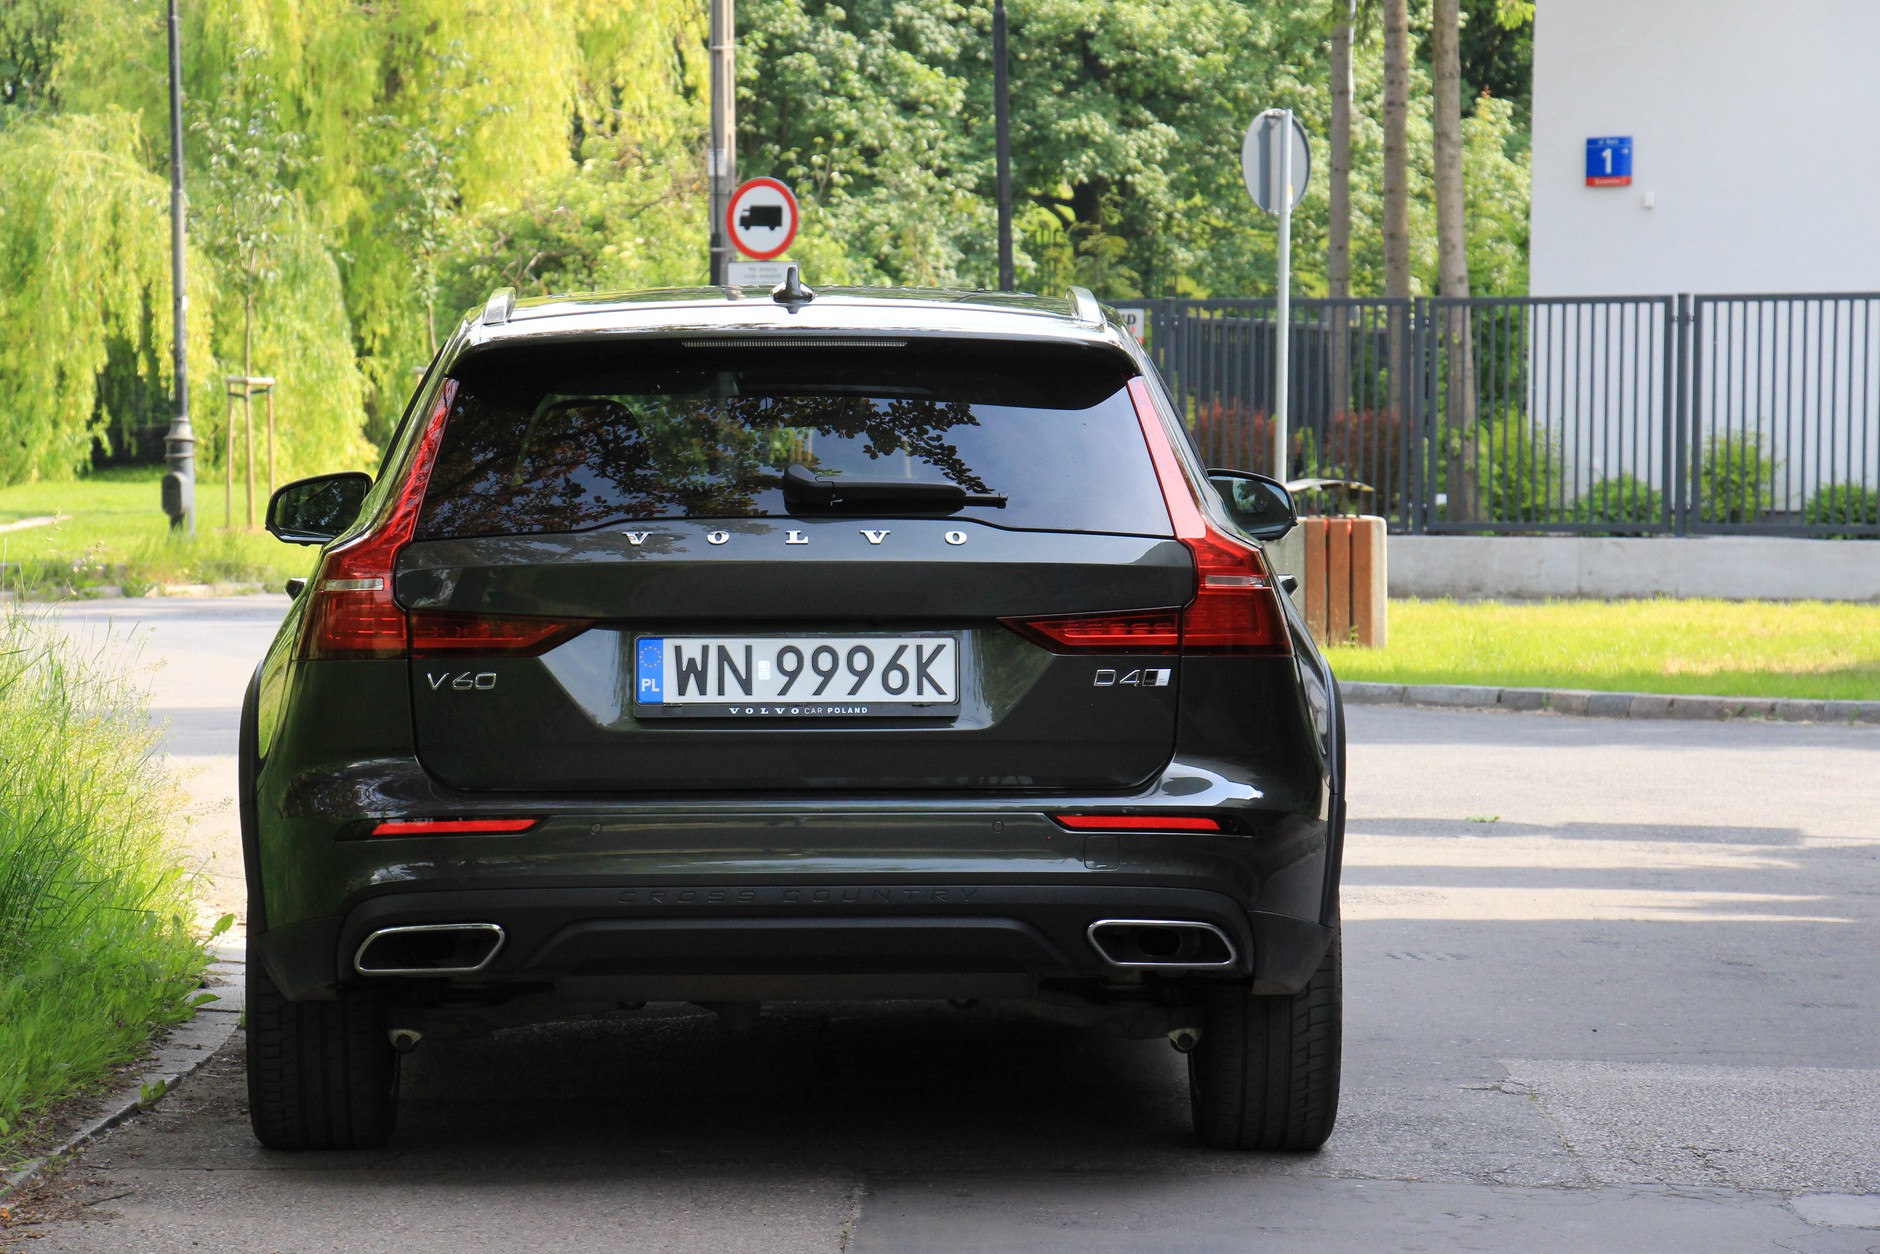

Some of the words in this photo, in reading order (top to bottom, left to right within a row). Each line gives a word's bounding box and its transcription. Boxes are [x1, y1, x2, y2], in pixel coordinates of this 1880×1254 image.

[1601, 147, 1612, 174] 1
[622, 530, 968, 546] VOLVO
[674, 644, 753, 697] WN
[776, 644, 948, 697] 9996K
[1093, 669, 1140, 687] D4
[426, 671, 497, 691] V60
[641, 678, 660, 692] PL
[729, 707, 800, 715] VOLVO
[804, 707, 823, 715] CAR
[618, 891, 757, 904] CROSS
[782, 889, 979, 904] COUNTRY
